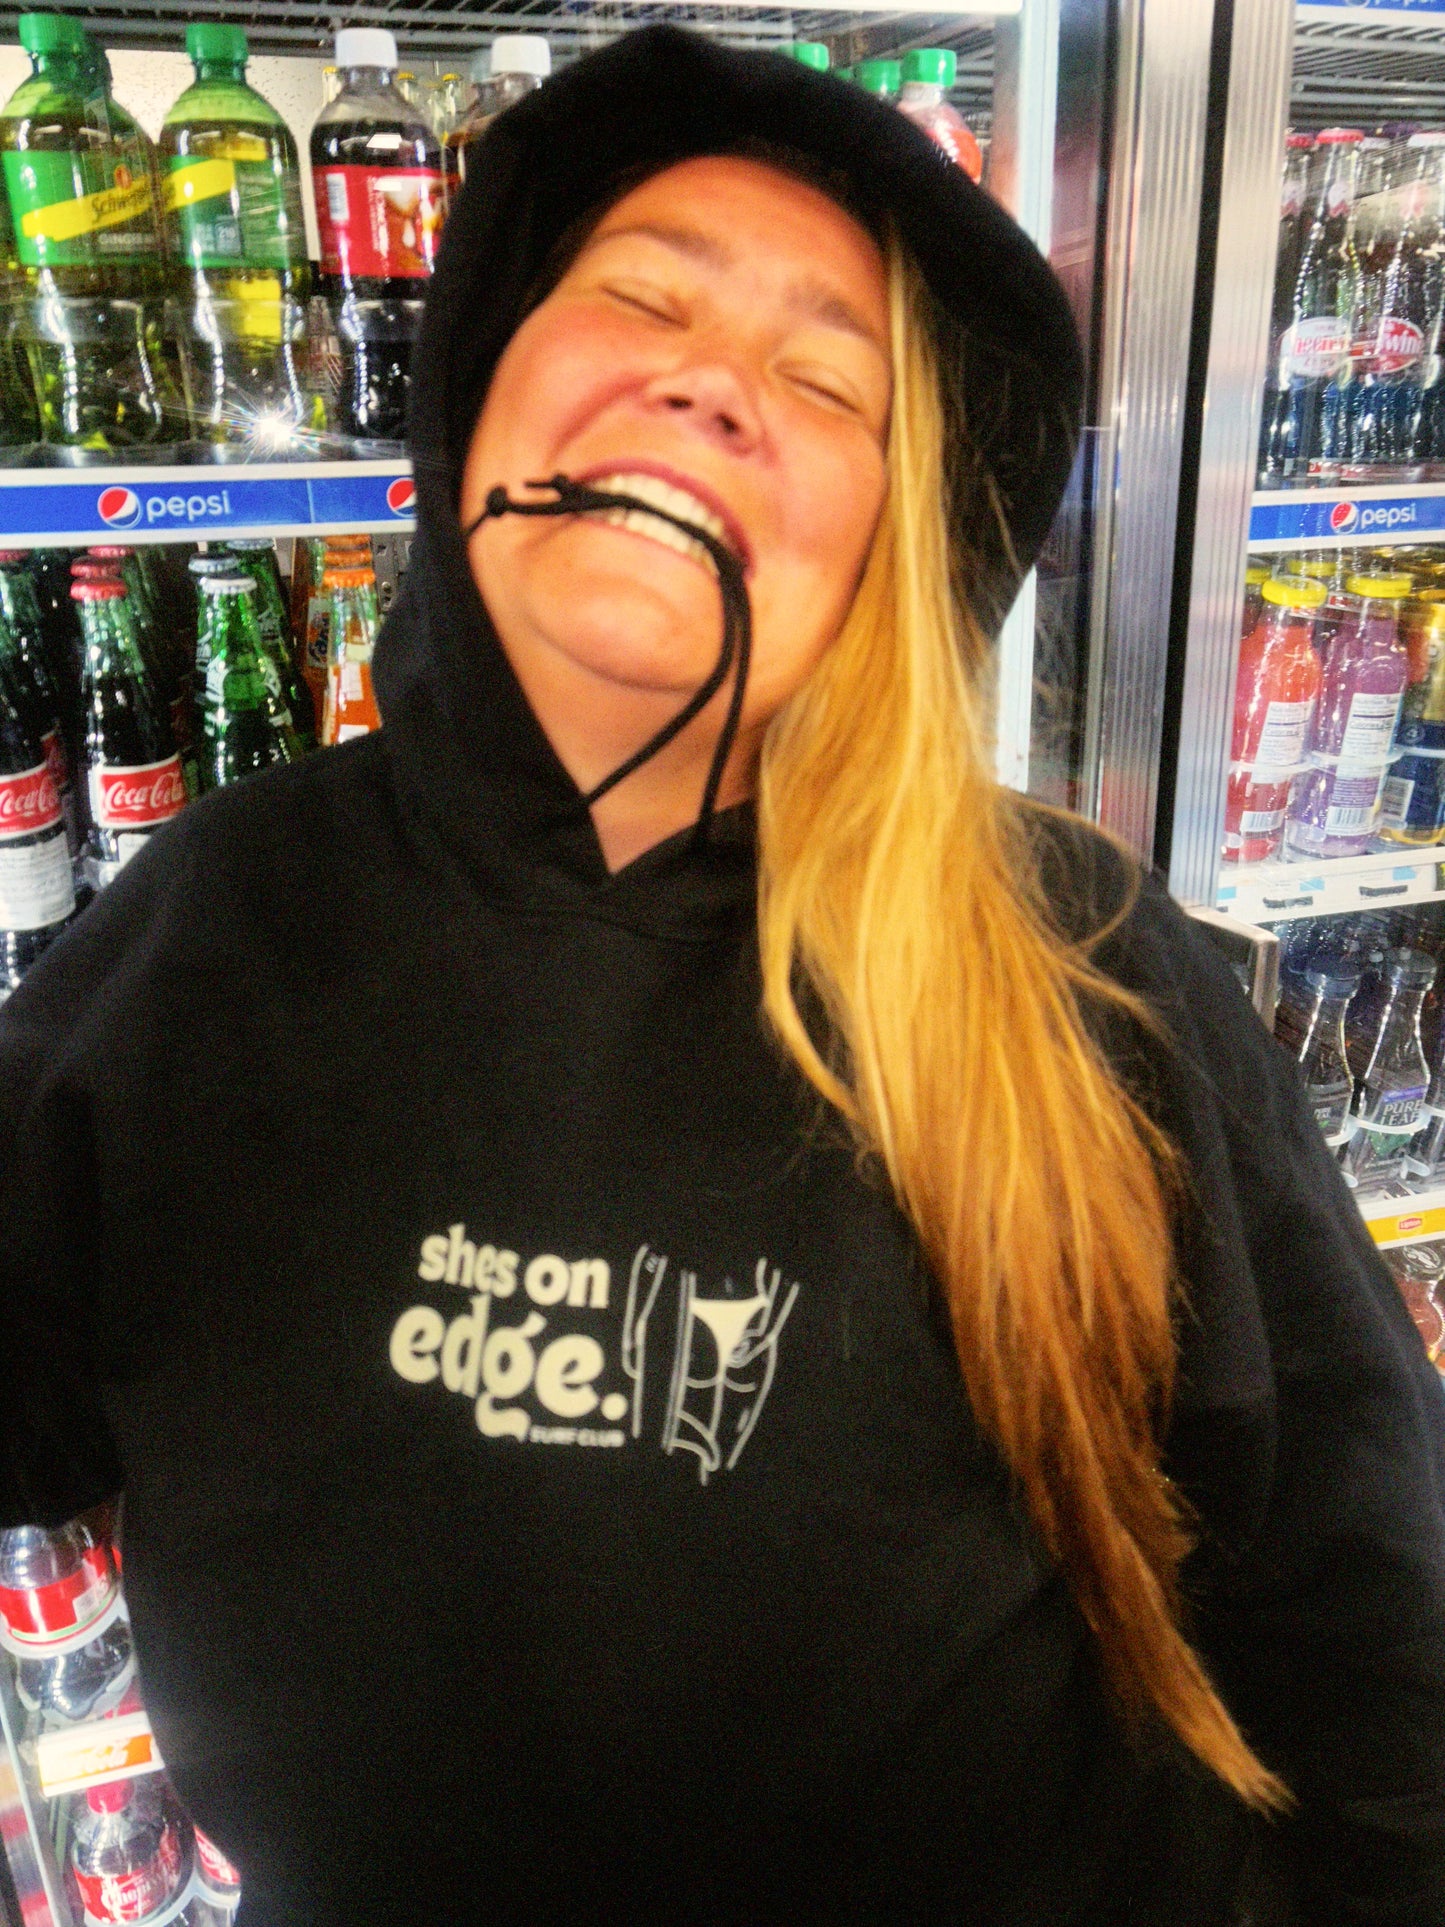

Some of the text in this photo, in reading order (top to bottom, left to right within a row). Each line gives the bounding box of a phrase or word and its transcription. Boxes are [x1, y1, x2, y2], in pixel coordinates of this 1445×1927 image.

[146, 490, 231, 523] pepsi
[1361, 503, 1416, 529] pepsi
[1380, 1112, 1421, 1126] LEAF
[1383, 1100, 1423, 1116] PURE
[418, 1223, 610, 1308] shes on
[389, 1294, 628, 1442] edge.
